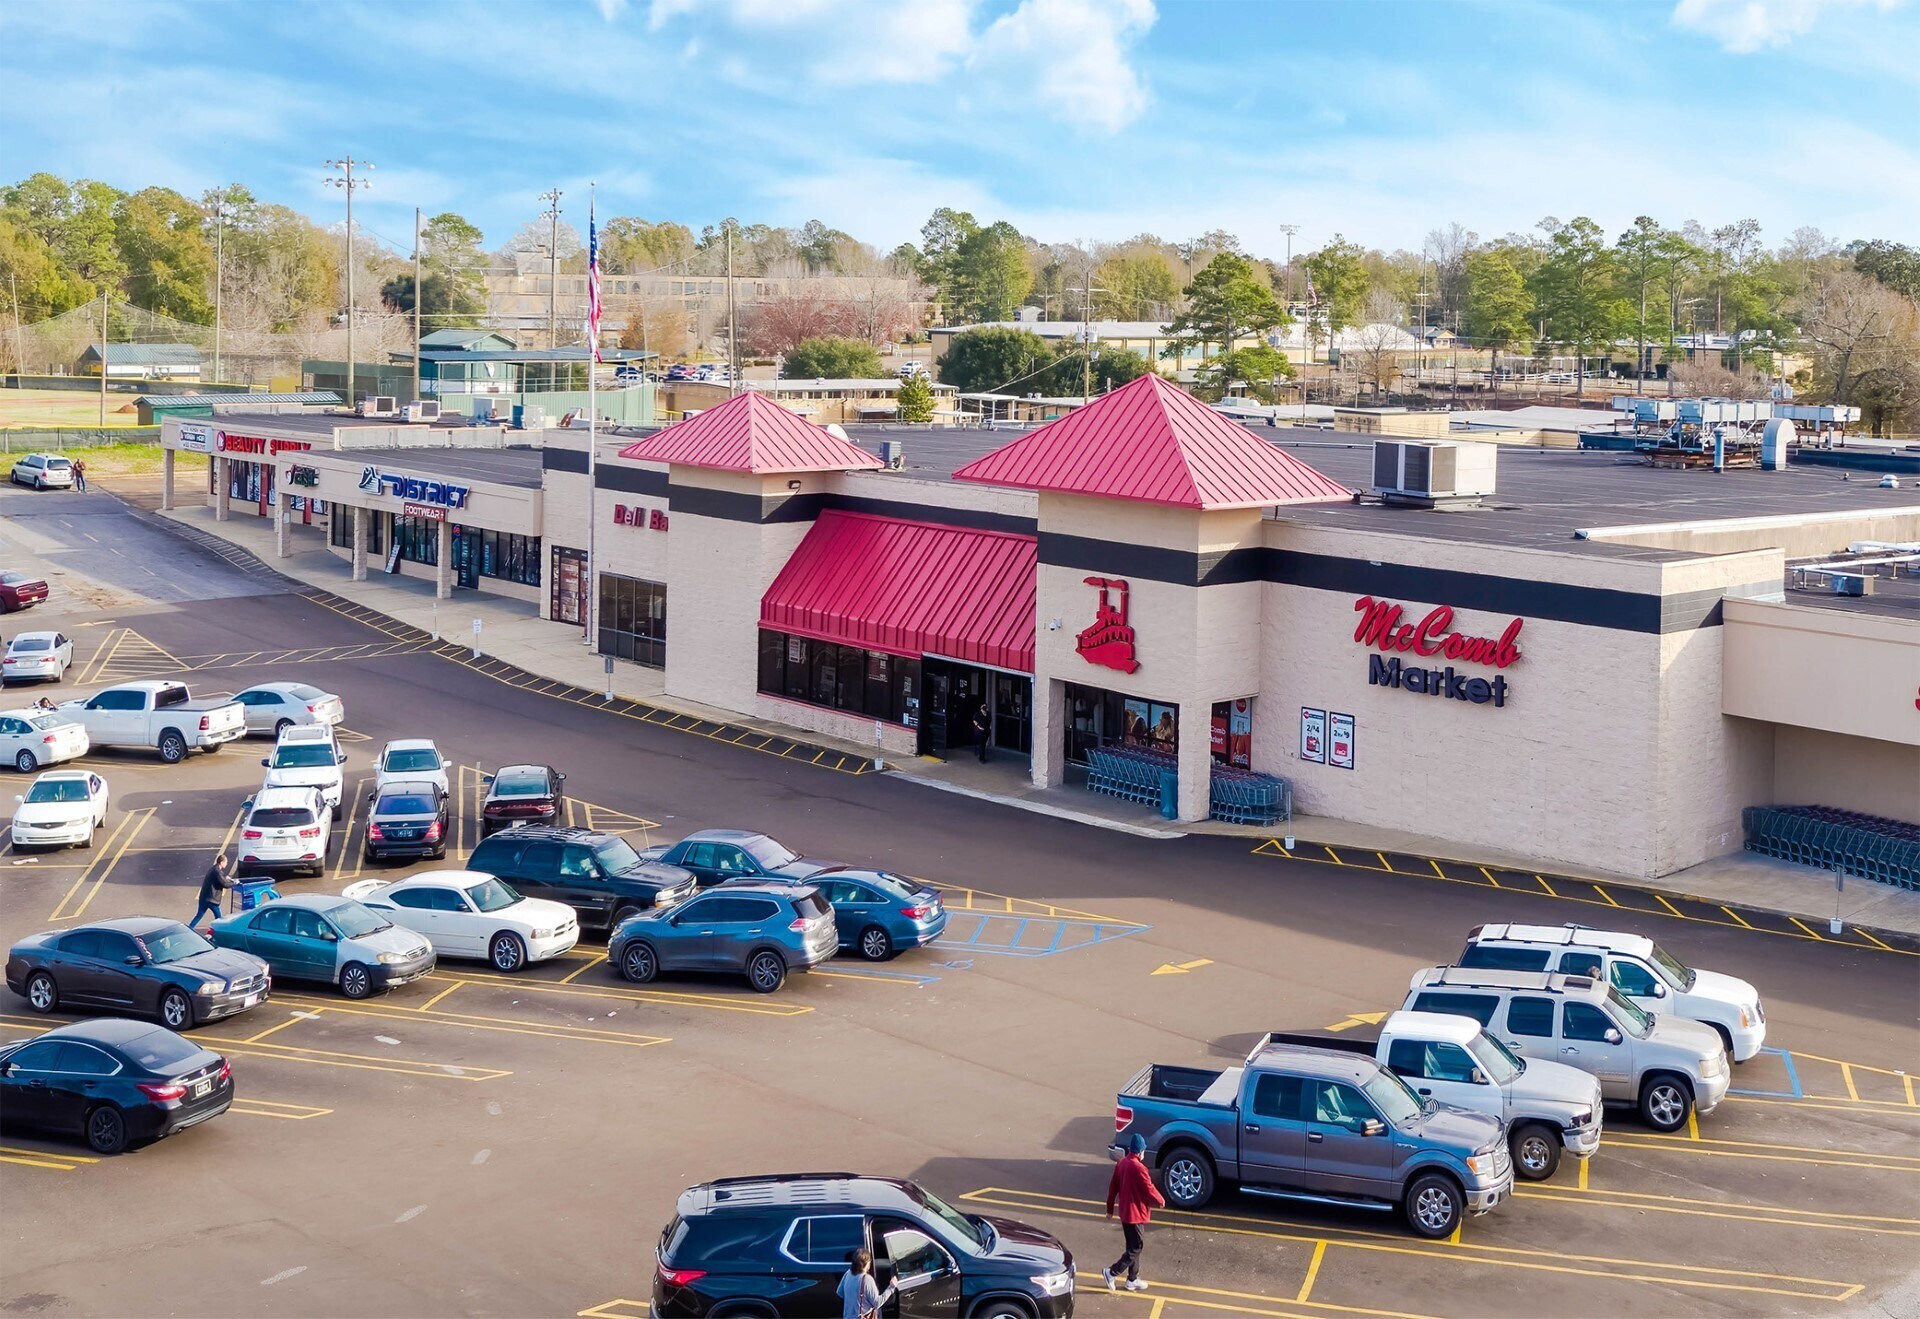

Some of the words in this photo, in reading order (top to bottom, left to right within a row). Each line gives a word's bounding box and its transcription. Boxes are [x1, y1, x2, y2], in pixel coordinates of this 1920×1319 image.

[226, 435, 266, 454] BEAUTY
[381, 474, 469, 509] DISTRICT
[614, 504, 645, 527] Deli
[1354, 595, 1524, 669] McComb
[1368, 654, 1508, 707] Market
